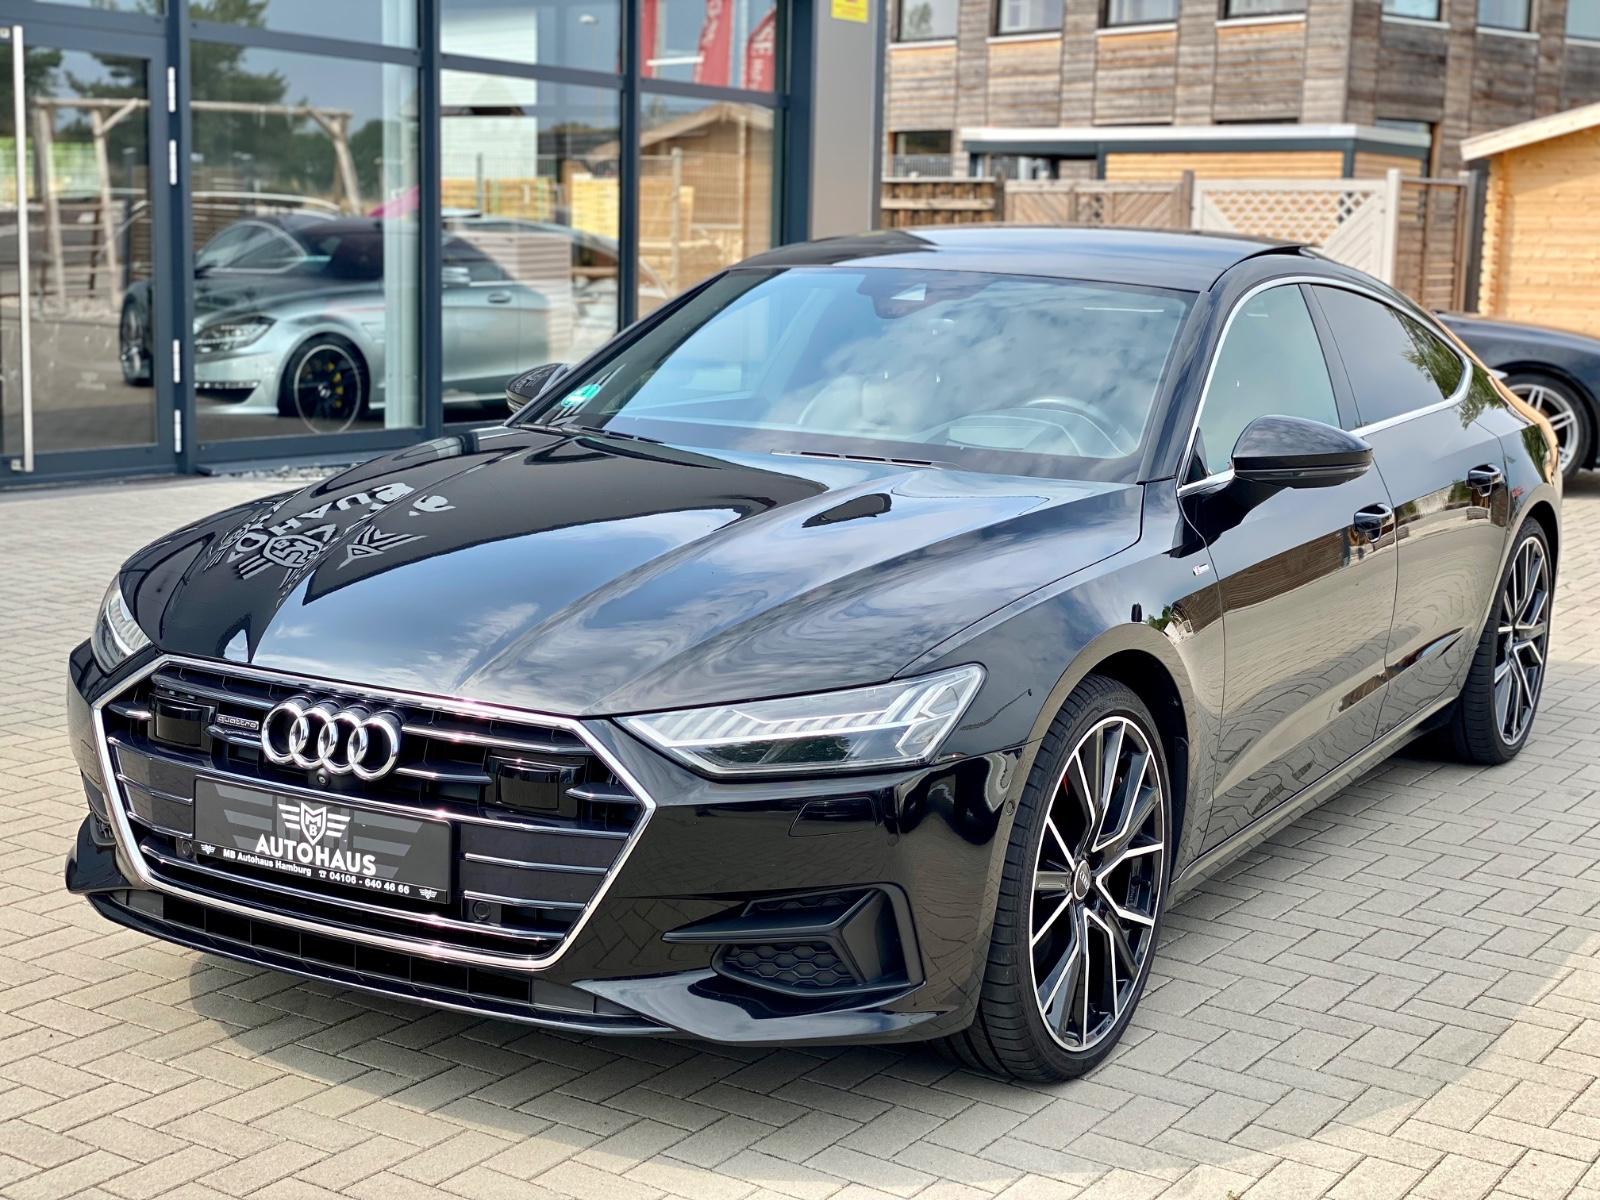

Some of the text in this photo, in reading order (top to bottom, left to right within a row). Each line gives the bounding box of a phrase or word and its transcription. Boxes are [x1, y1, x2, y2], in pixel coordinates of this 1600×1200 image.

[217, 716, 257, 729] quattro
[223, 848, 236, 859] MB
[237, 852, 274, 868] Autohaus
[275, 861, 312, 877] Hamburg
[364, 878, 382, 889] 640
[383, 882, 396, 892] 46
[397, 885, 410, 895] 66
[255, 833, 377, 876] AUTOHAUS
